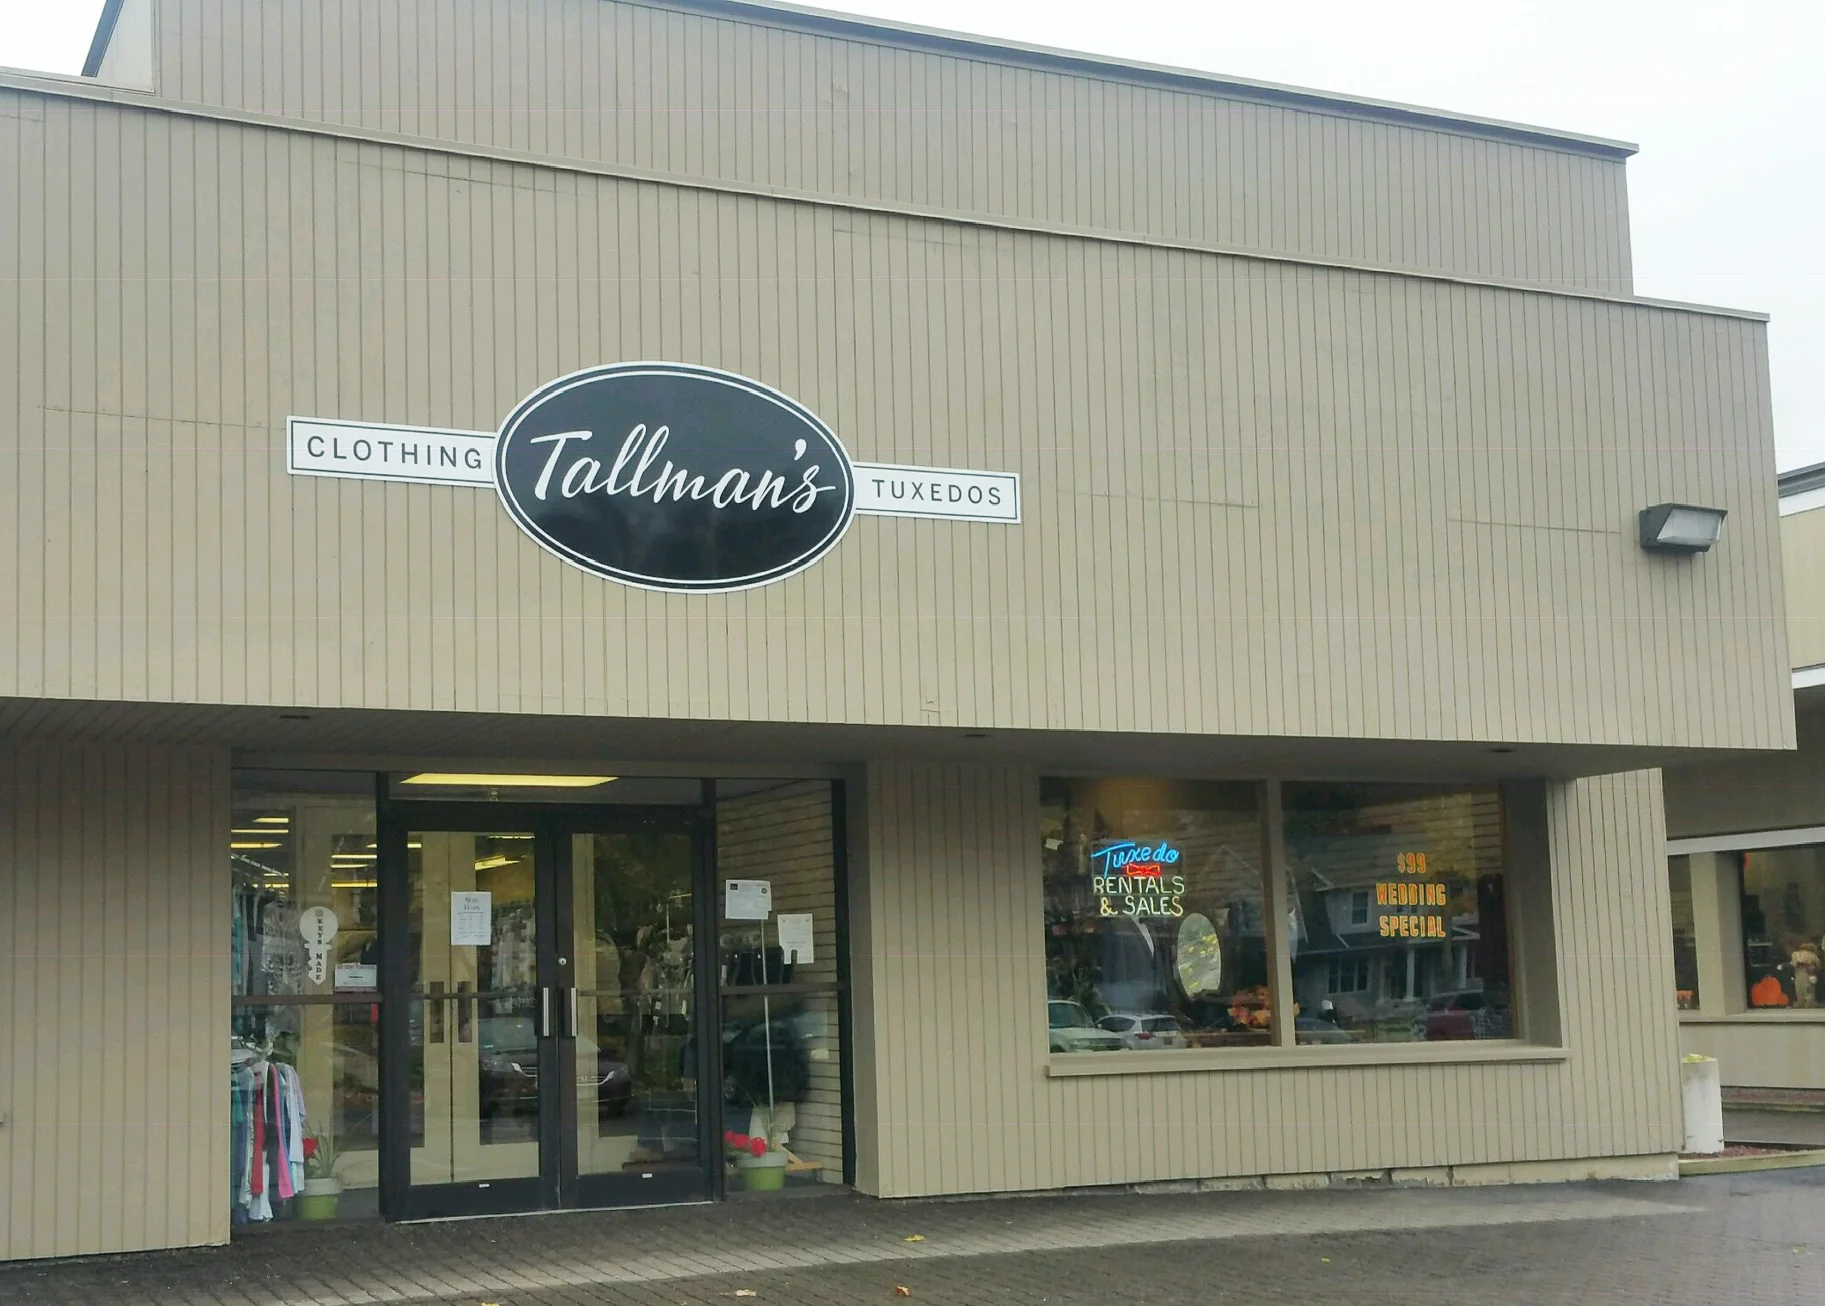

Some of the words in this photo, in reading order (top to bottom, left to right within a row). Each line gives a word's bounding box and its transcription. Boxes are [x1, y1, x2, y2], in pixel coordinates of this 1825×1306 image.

[307, 435, 483, 470] CLOTHING
[530, 423, 836, 514] Tallman's
[871, 479, 1002, 506] TUXEDOS
[1091, 841, 1180, 879] Tuxedo
[1397, 852, 1426, 874] $99
[1093, 876, 1185, 895] RENTALS
[1376, 883, 1447, 906] WEDDING
[1100, 896, 1118, 917] &
[1122, 895, 1184, 917] SALES
[316, 918, 324, 945] KEYS
[1380, 915, 1447, 938] SPECIAL
[315, 952, 323, 980] MADE
